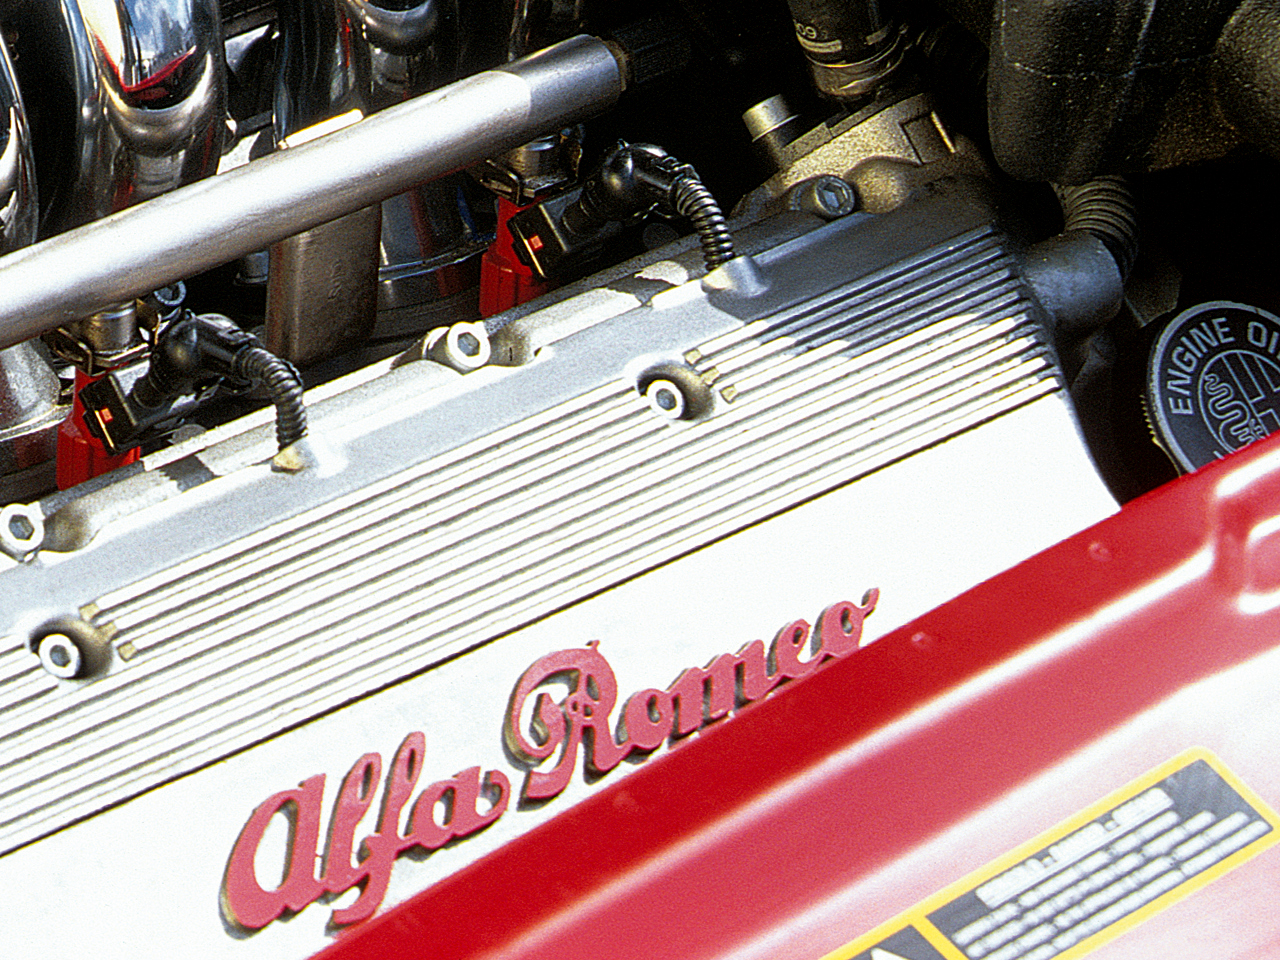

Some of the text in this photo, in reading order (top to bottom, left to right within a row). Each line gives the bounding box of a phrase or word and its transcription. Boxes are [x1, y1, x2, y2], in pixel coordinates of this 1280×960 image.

[1167, 317, 1280, 416] ENGINE OI
[220, 587, 881, 936] Alfa Romeo
